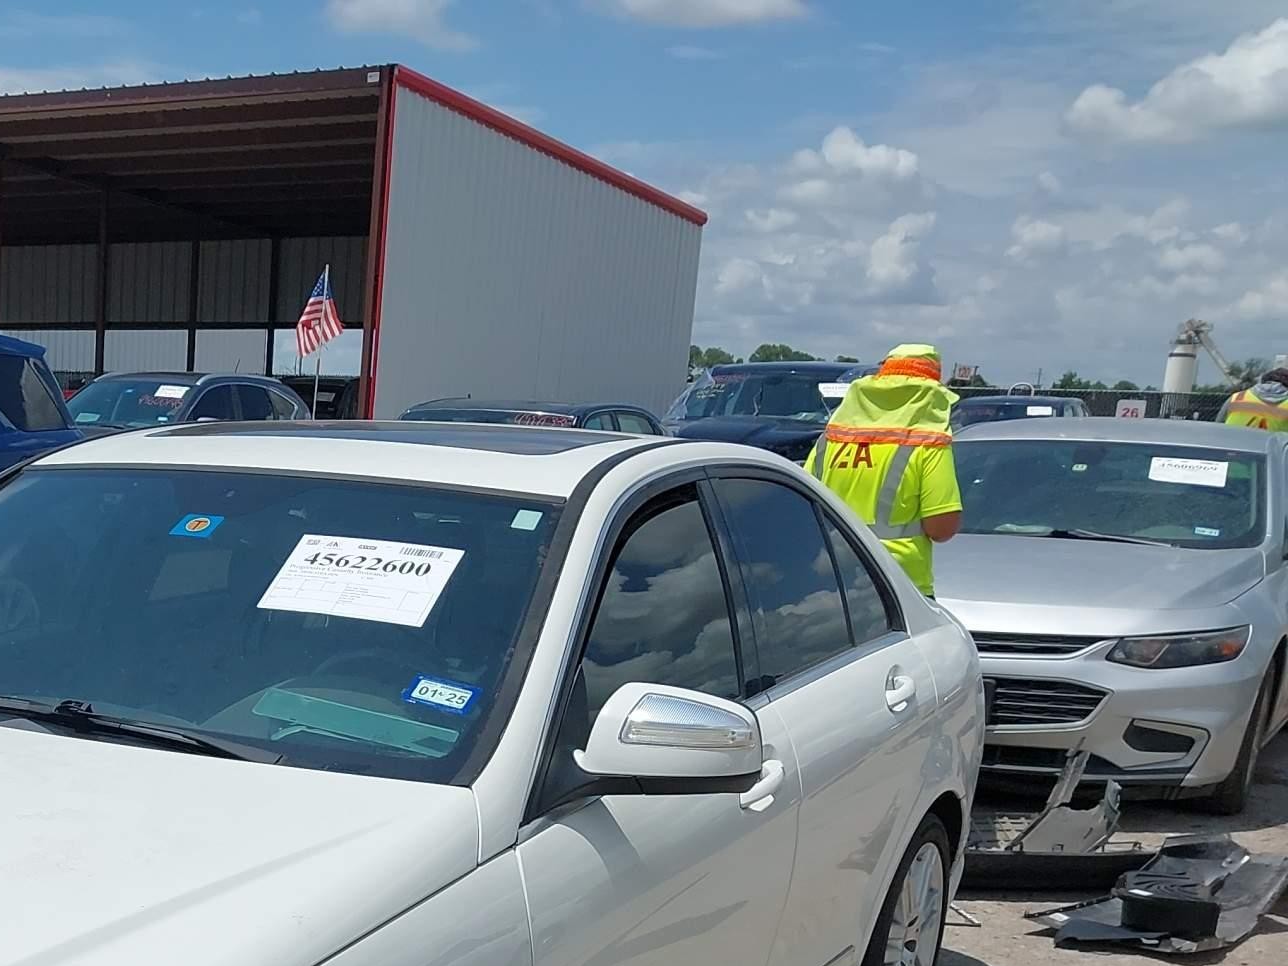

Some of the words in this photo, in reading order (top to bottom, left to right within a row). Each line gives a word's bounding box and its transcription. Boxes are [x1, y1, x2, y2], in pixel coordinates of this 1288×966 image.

[304, 551, 432, 577] 45622600
[418, 685, 439, 698] 01
[445, 692, 467, 705] 25
